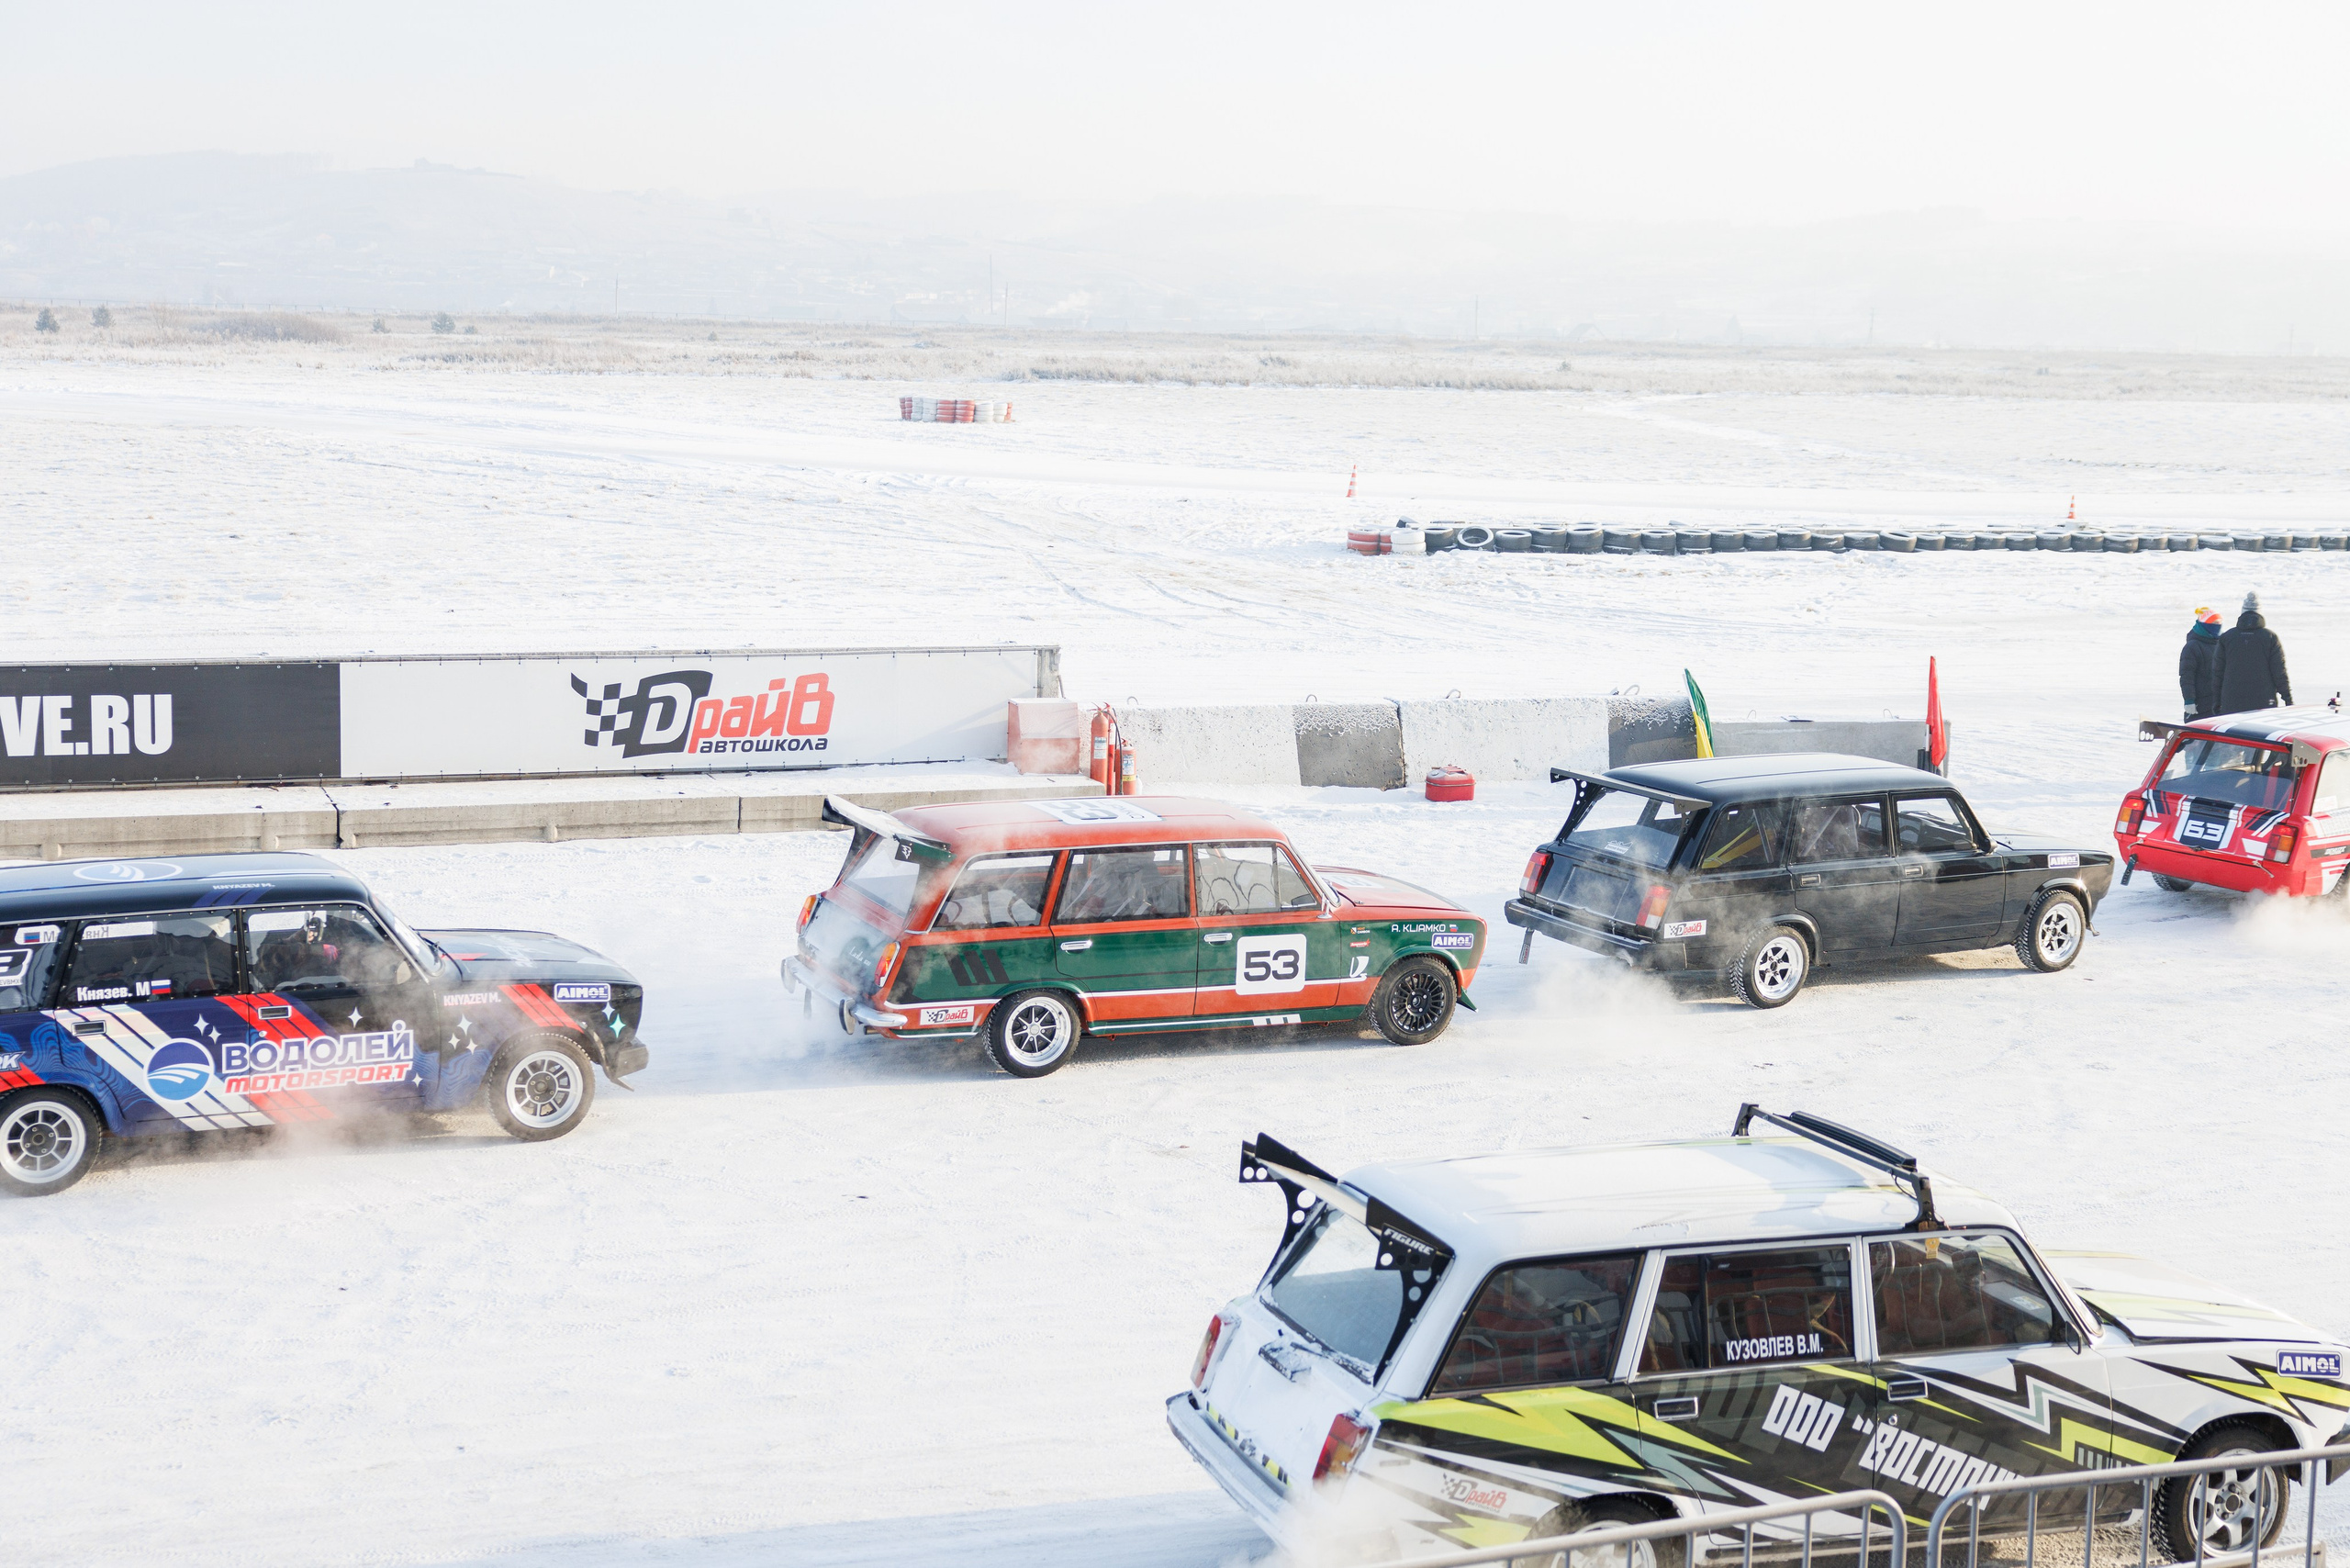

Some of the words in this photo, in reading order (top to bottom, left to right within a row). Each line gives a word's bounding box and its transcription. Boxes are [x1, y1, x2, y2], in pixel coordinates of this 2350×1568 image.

[699, 738, 828, 753] автошкола
[2183, 819, 2226, 842] 63
[1391, 924, 1401, 933] A.
[1403, 924, 1447, 933] KLIAMKO
[1434, 935, 1472, 946] AIMOL
[1243, 948, 1301, 982] 53
[77, 986, 133, 1002] Князев.
[136, 980, 151, 997] М
[442, 992, 488, 1007] KNYAZEV
[489, 991, 502, 1003] M.
[557, 986, 608, 999] AIMOL
[223, 1021, 413, 1072] ВОДОЛЕЙ
[224, 1063, 411, 1094] MOTORSPORT
[1383, 1227, 1435, 1256] FIGURE
[1727, 1336, 1795, 1361] КУЗОВЛЕВ
[1796, 1333, 1824, 1355] В.М.
[2280, 1355, 2340, 1373] AIMOL
[1762, 1383, 1845, 1452] ООО
